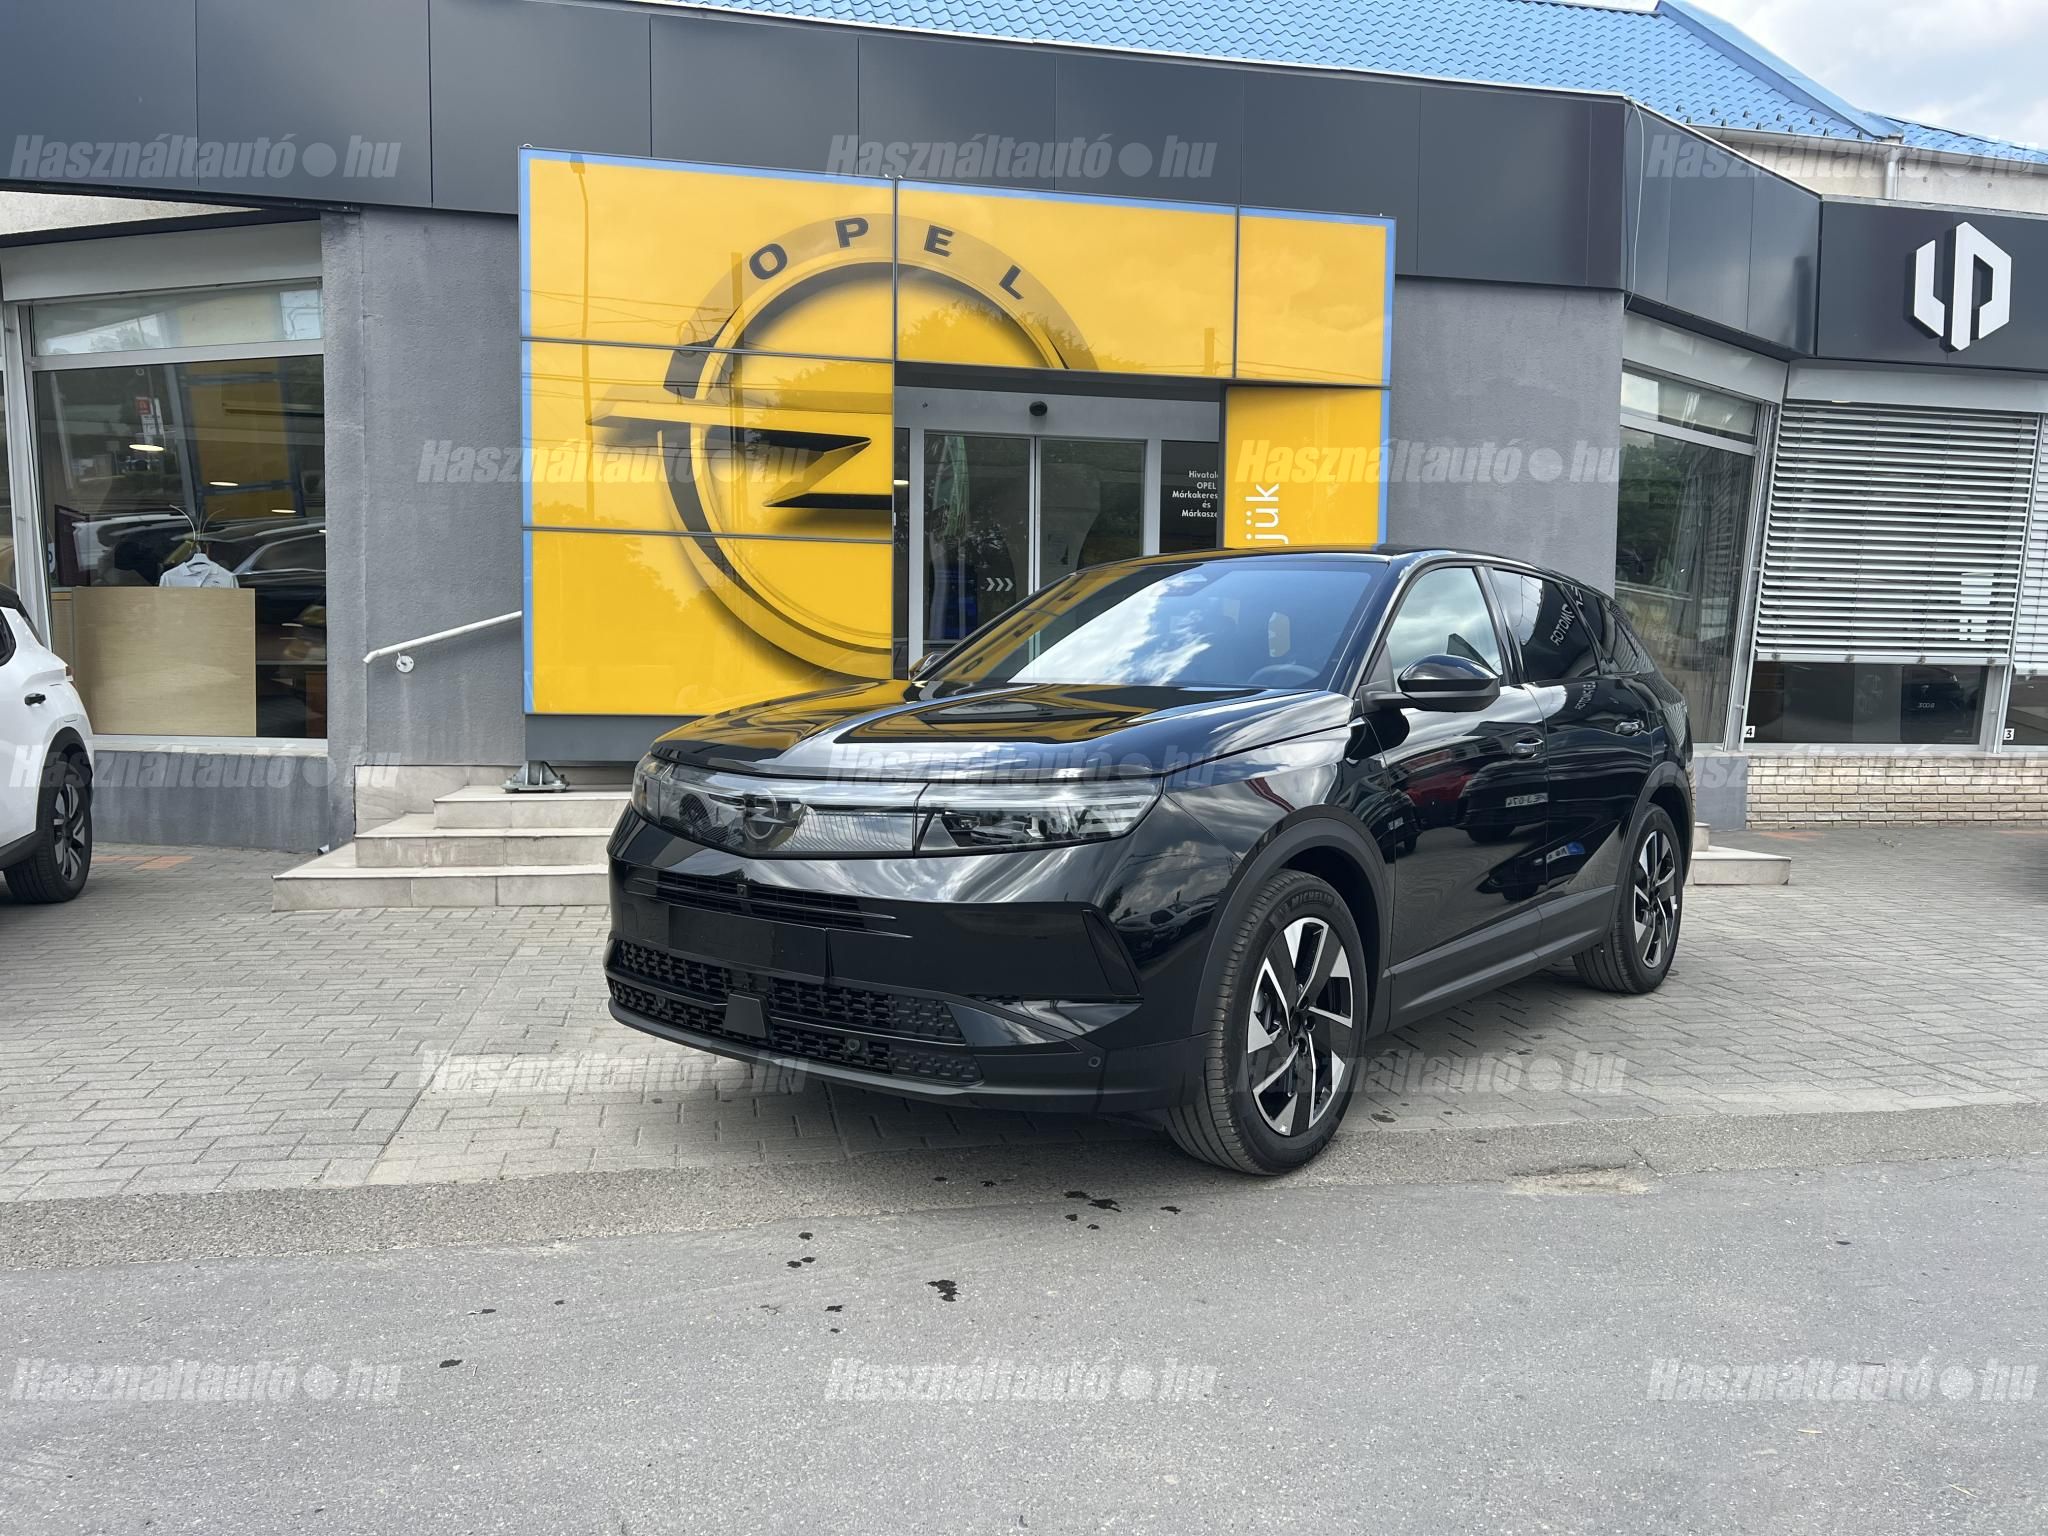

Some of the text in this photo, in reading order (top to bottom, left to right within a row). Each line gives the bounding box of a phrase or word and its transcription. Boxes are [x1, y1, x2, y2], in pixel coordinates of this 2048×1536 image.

[748, 216, 1025, 300] OPEL
[1196, 481, 1217, 490] OPEL
[1201, 500, 1211, 508] és
